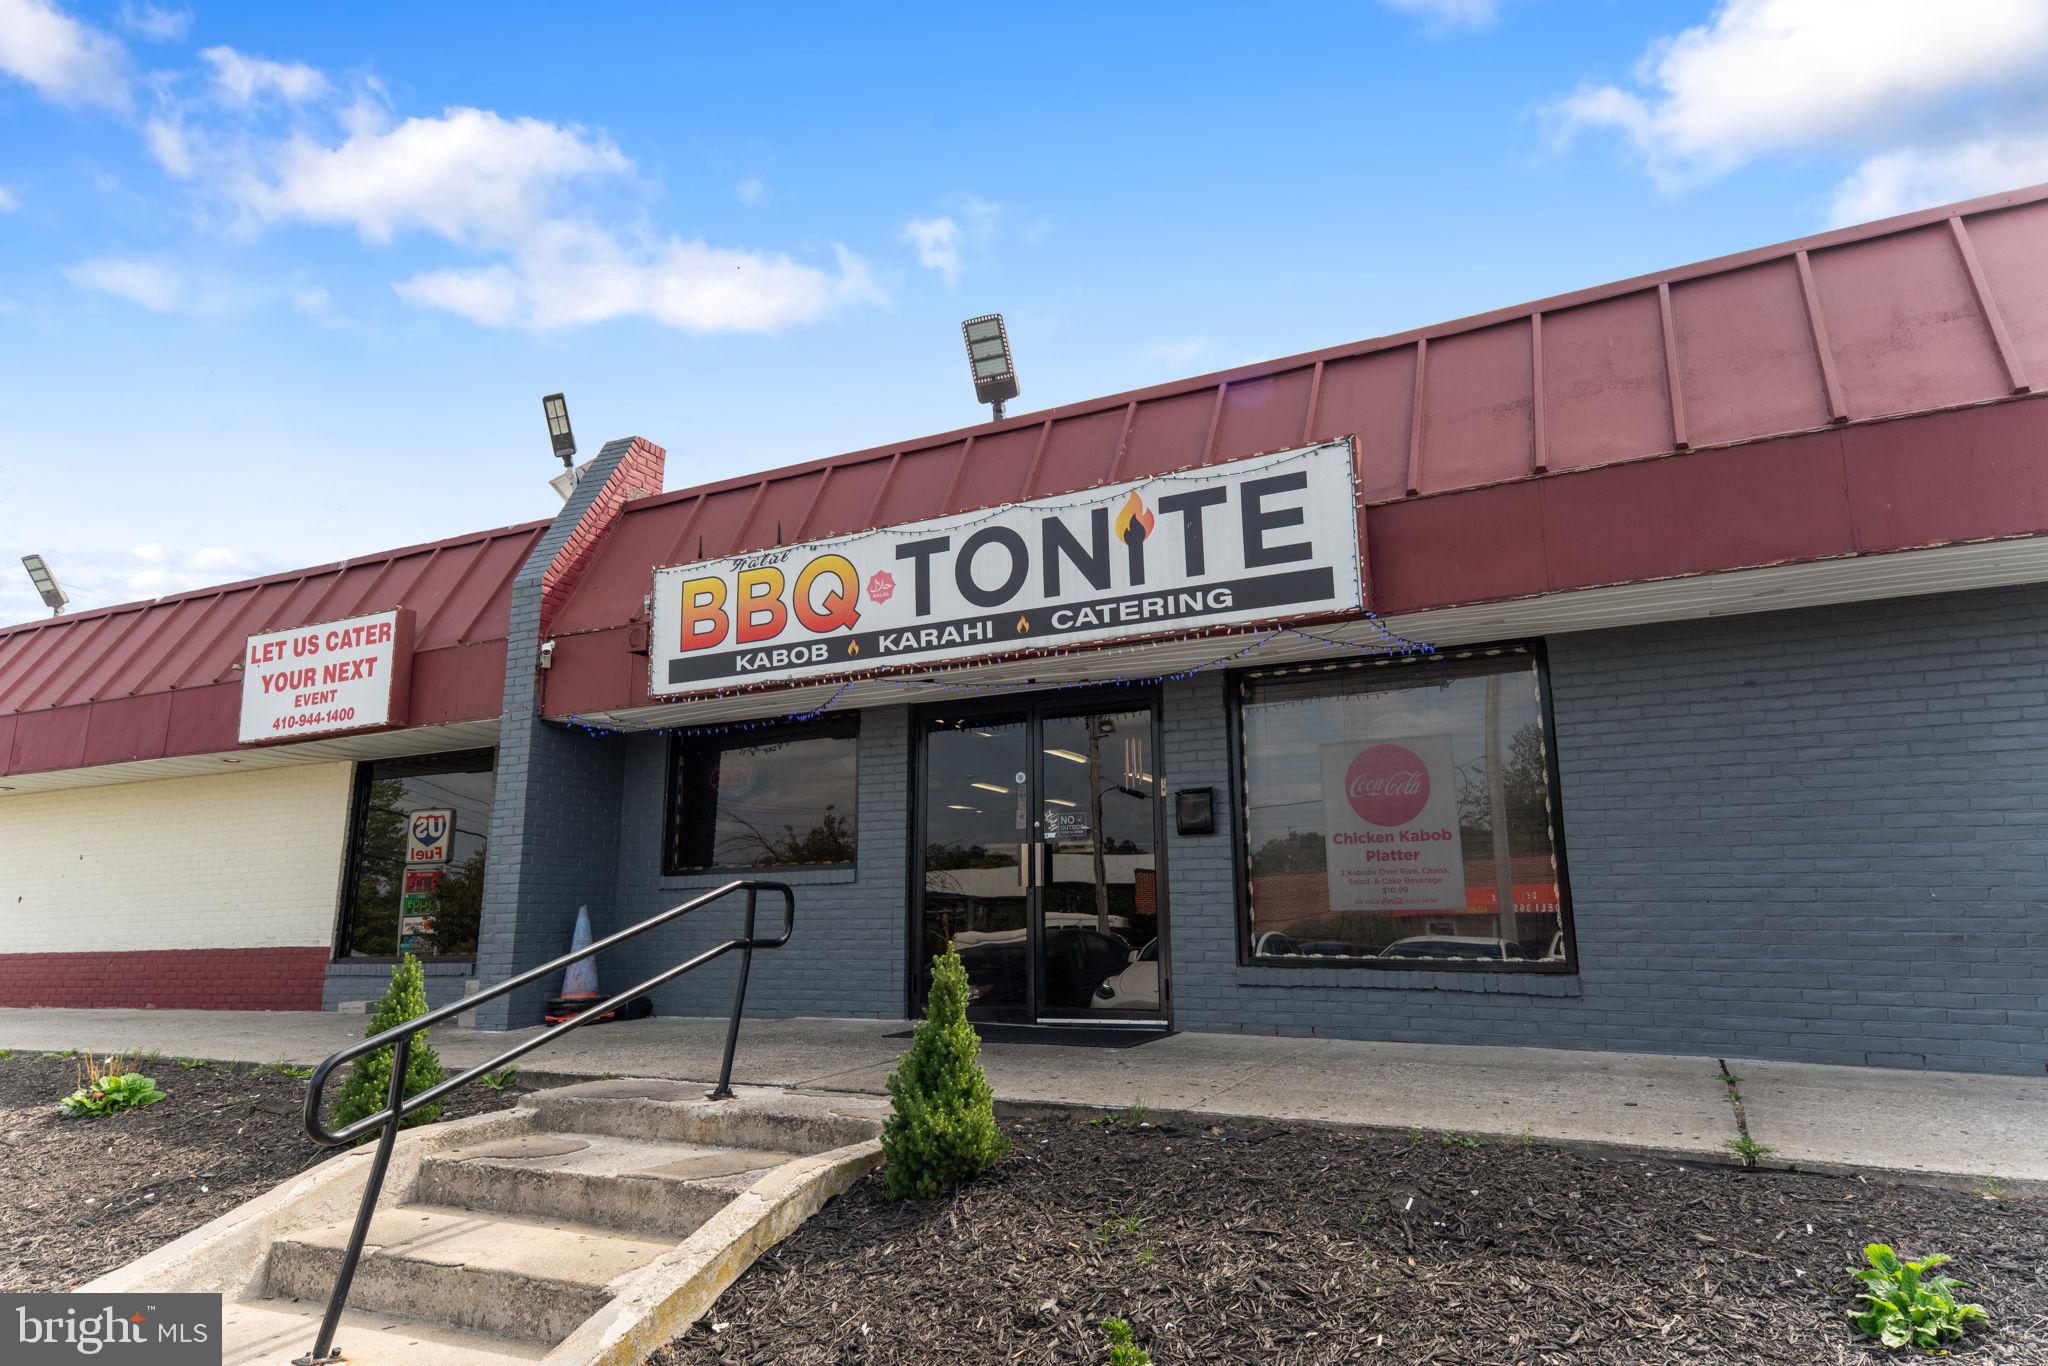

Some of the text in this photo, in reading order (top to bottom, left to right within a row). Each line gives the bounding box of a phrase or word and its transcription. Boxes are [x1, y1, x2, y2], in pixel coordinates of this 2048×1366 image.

[680, 470, 1314, 652] BBQ TONITE
[730, 550, 791, 572] Halal
[872, 591, 890, 599] HALAL
[736, 588, 1233, 672] KABOB KARAHI CATERING
[250, 622, 392, 665] LET US CATER
[261, 656, 378, 694] YOUR NEXT
[294, 689, 338, 708] EVENT
[272, 707, 355, 730] 410-944-1400
[1350, 771, 1425, 799] Coca-Cola
[1060, 815, 1075, 825] NO
[1333, 828, 1453, 845] Chicken Kabob
[1366, 849, 1420, 862] Platter
[1347, 868, 1377, 876] Kabobs
[1400, 867, 1420, 876] Rice,
[1381, 877, 1401, 885] Coke
[1404, 877, 1442, 886] Beverage
[1382, 886, 1408, 894] $10.99
